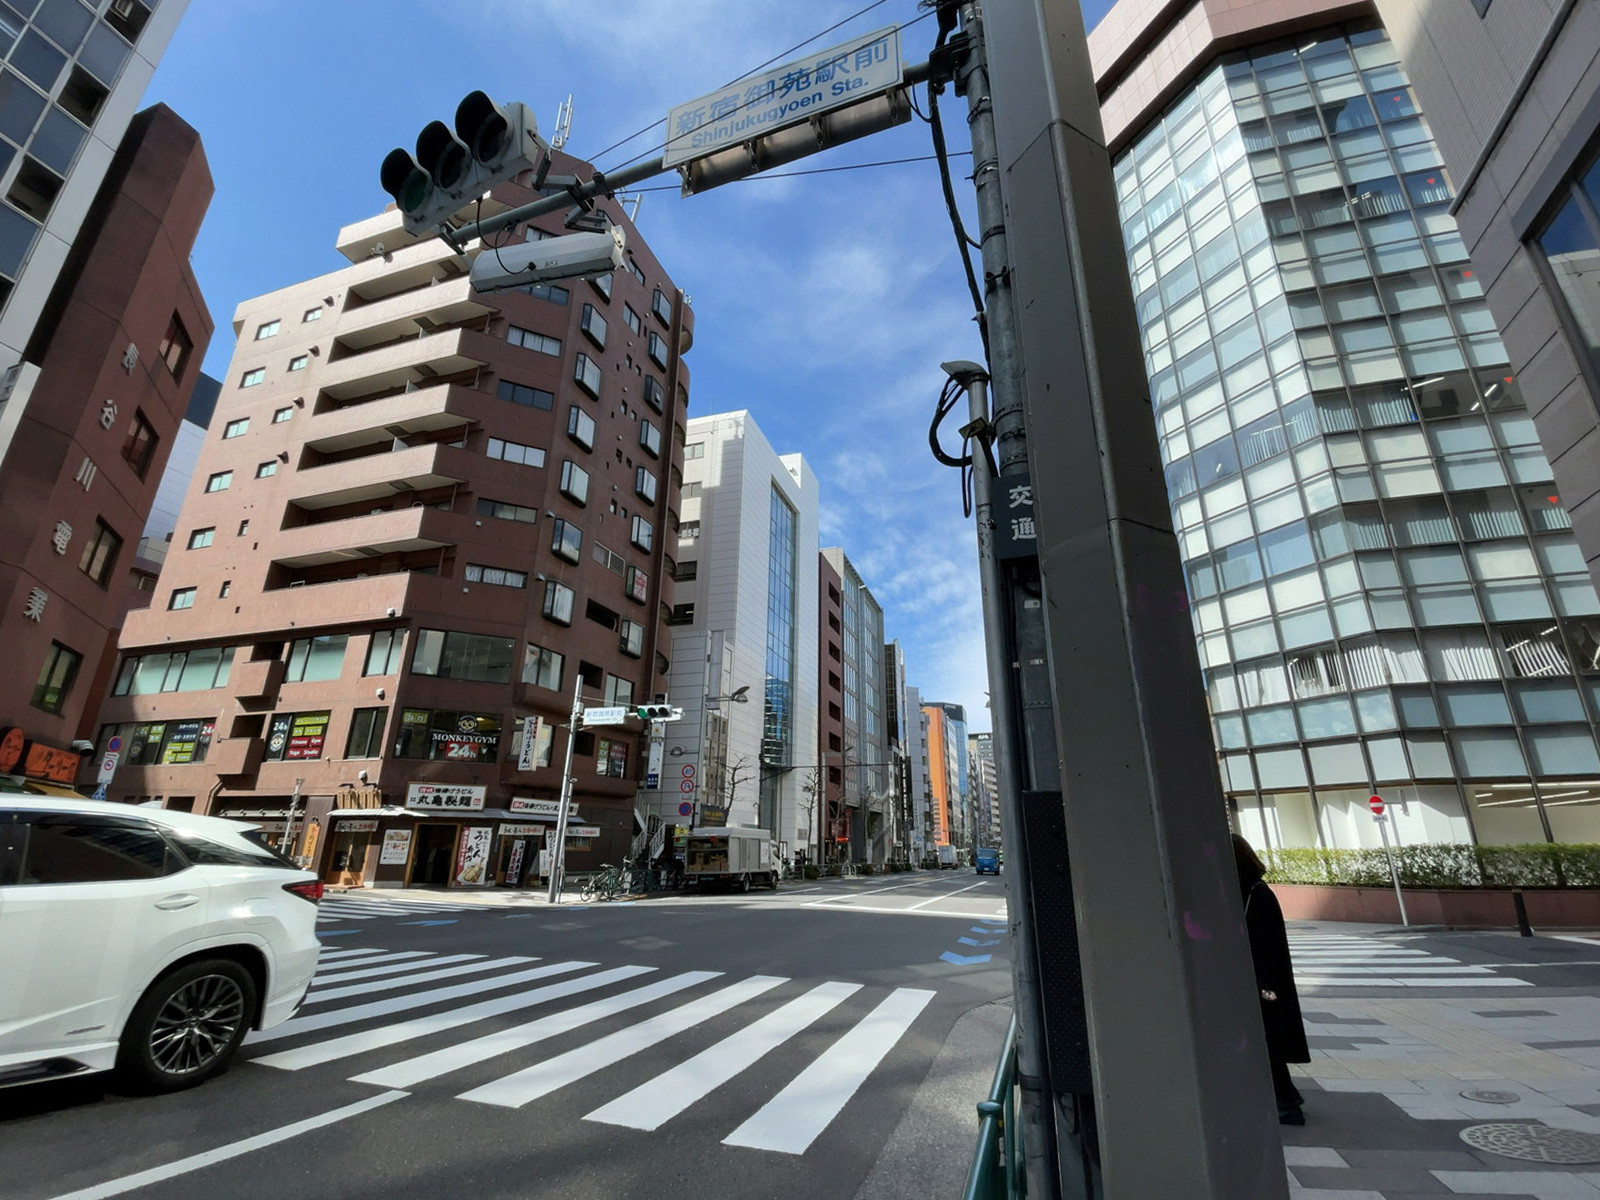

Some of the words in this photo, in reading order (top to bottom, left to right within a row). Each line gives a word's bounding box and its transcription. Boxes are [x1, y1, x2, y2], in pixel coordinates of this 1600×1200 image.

[674, 35, 890, 136] 新宿御苑駅前
[690, 90, 824, 149] Shinjukugyoen
[831, 76, 869, 98] Sta.
[1008, 485, 1037, 541] 交通
[432, 732, 497, 745] MONKEYGYM
[447, 743, 477, 758] 24h
[417, 794, 473, 807] 丸亀製麺
